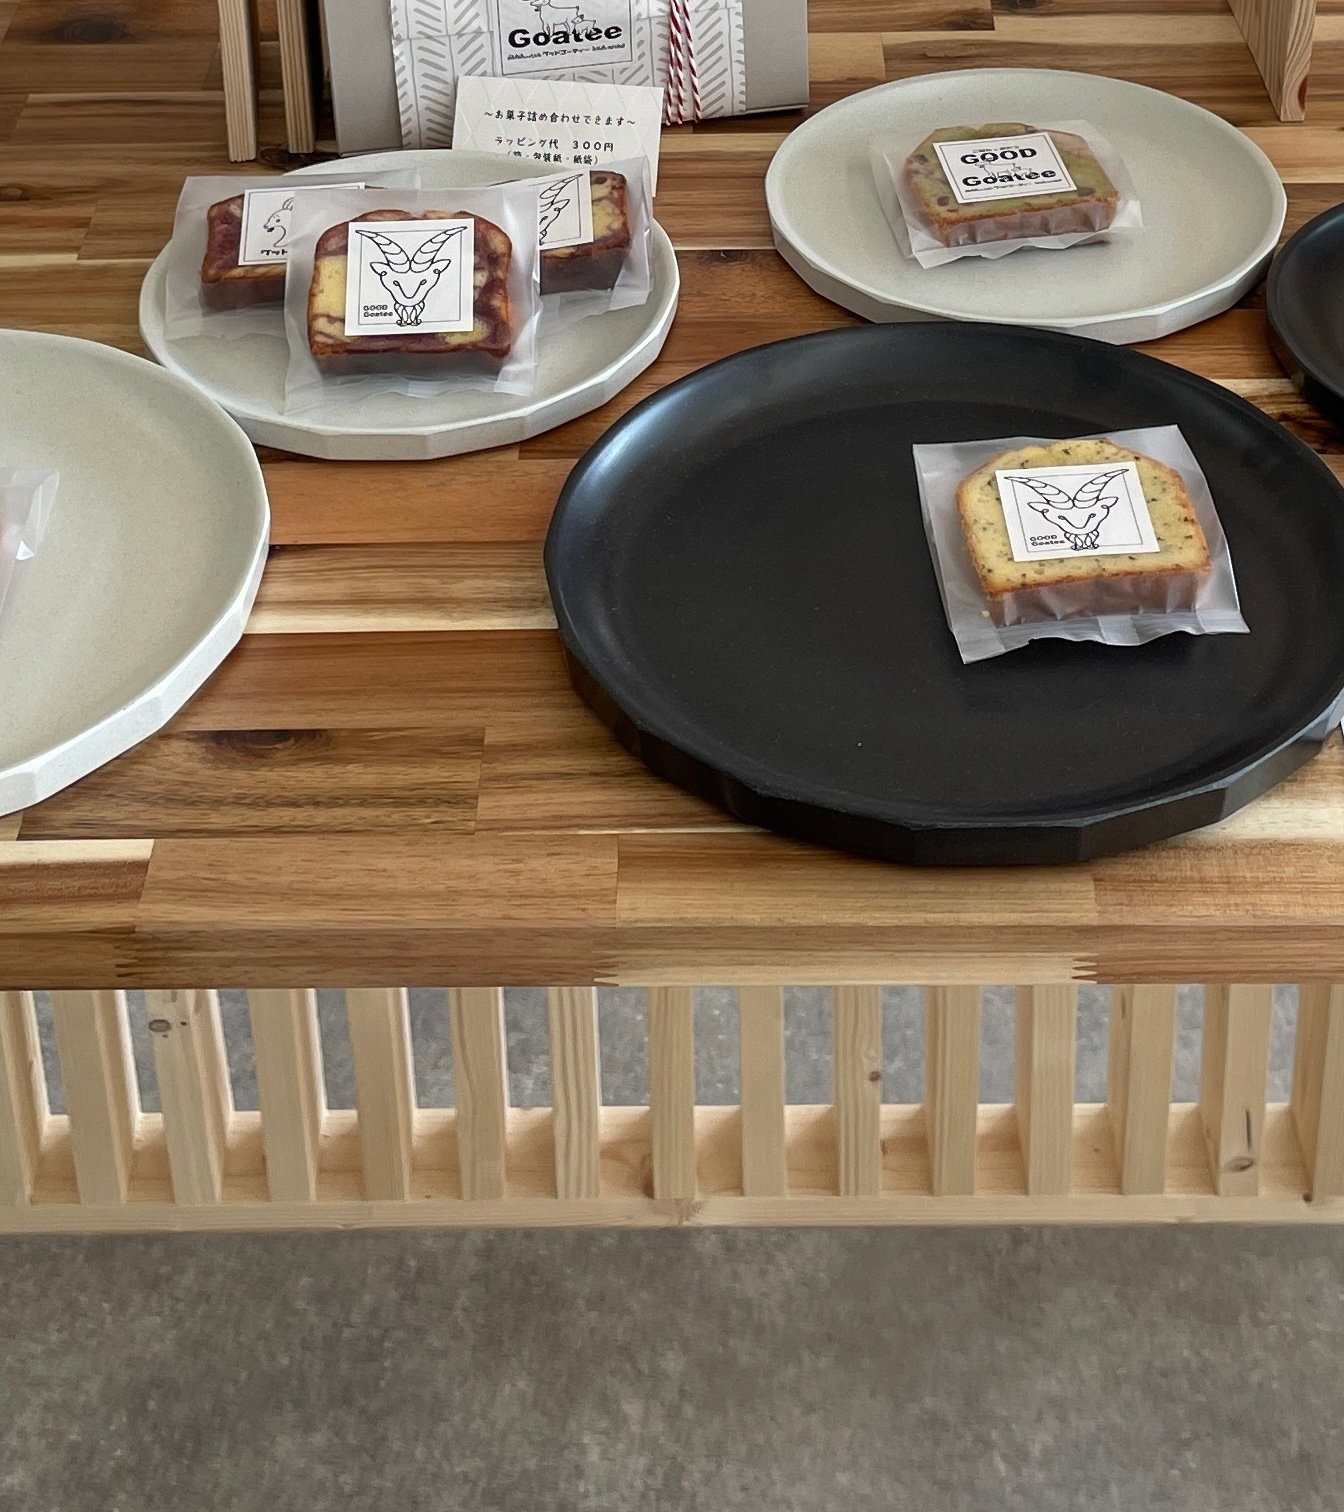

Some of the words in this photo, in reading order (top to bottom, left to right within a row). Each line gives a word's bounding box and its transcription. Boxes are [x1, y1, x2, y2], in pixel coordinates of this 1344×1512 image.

[508, 25, 623, 49] Goatee
[494, 136, 559, 150] ラッピング代
[572, 140, 614, 153] 300円
[960, 148, 1038, 165] GOOD
[962, 170, 1057, 187] Goatee
